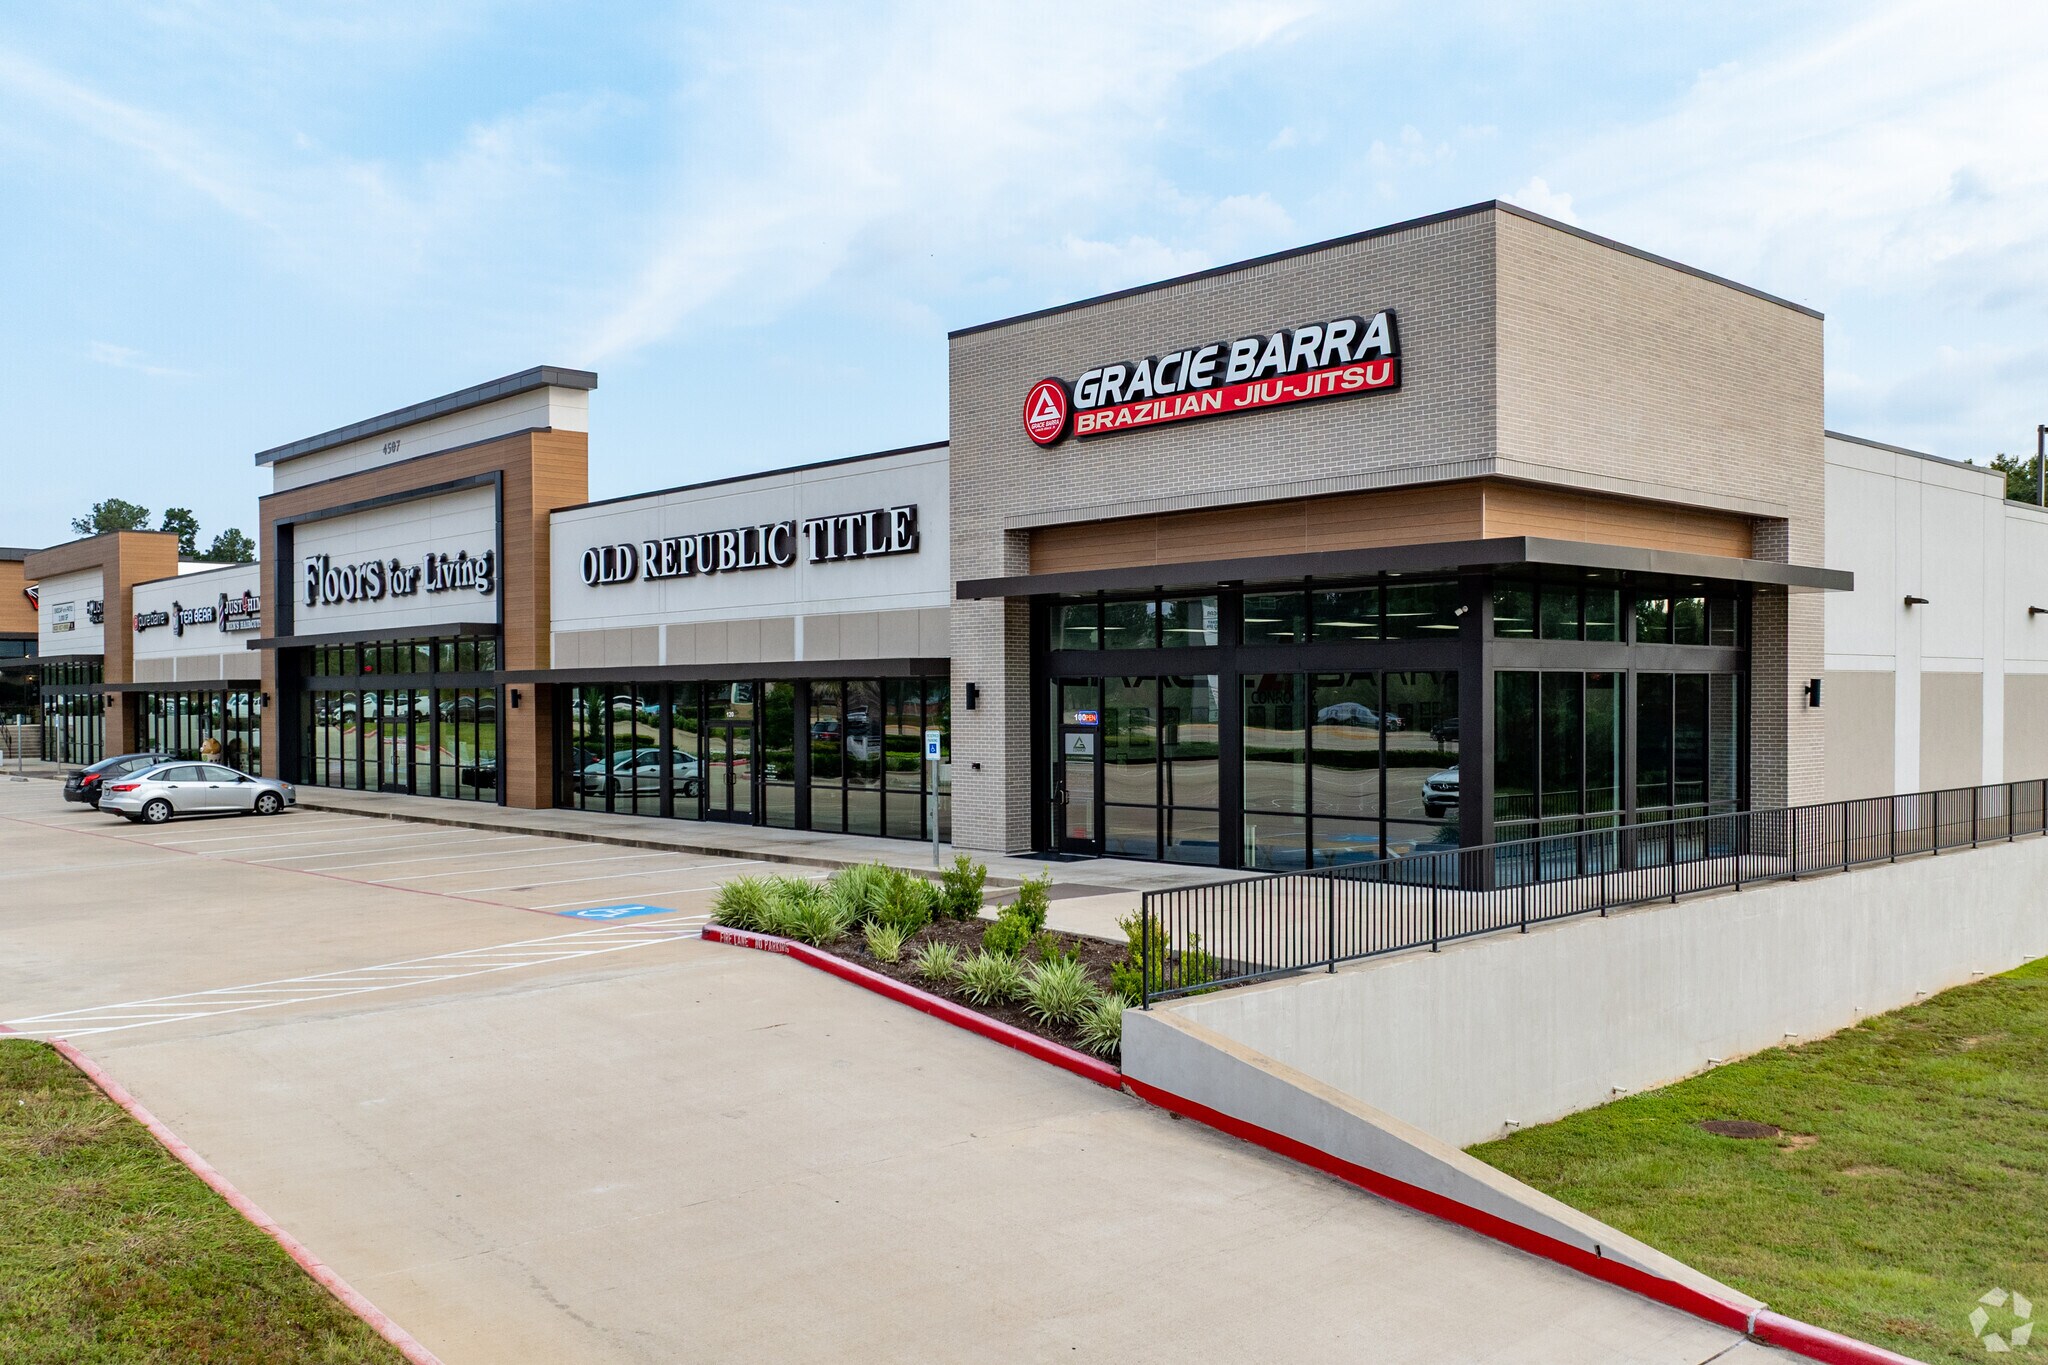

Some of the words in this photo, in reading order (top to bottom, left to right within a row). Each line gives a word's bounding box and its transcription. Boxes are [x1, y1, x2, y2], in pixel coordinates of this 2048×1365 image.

[1073, 343, 1221, 410] GRACIE
[1225, 312, 1393, 384] BARRA
[1077, 390, 1223, 434] BRAZILIAN
[1234, 362, 1391, 408] JIU-JITSU
[383, 440, 401, 455] 4507
[579, 545, 635, 586] OLD
[640, 521, 793, 580] REPUBLIC
[802, 506, 916, 563] TITLE
[302, 554, 384, 606] Floors
[386, 559, 416, 597] for
[423, 552, 491, 593] Living
[180, 610, 193, 624] TEA
[194, 607, 213, 622] BEAR
[225, 600, 243, 615] JUST
[719, 932, 732, 944] FIRE
[734, 934, 749, 947] LANE
[755, 938, 763, 950] NO
[764, 940, 790, 954] PARKING
